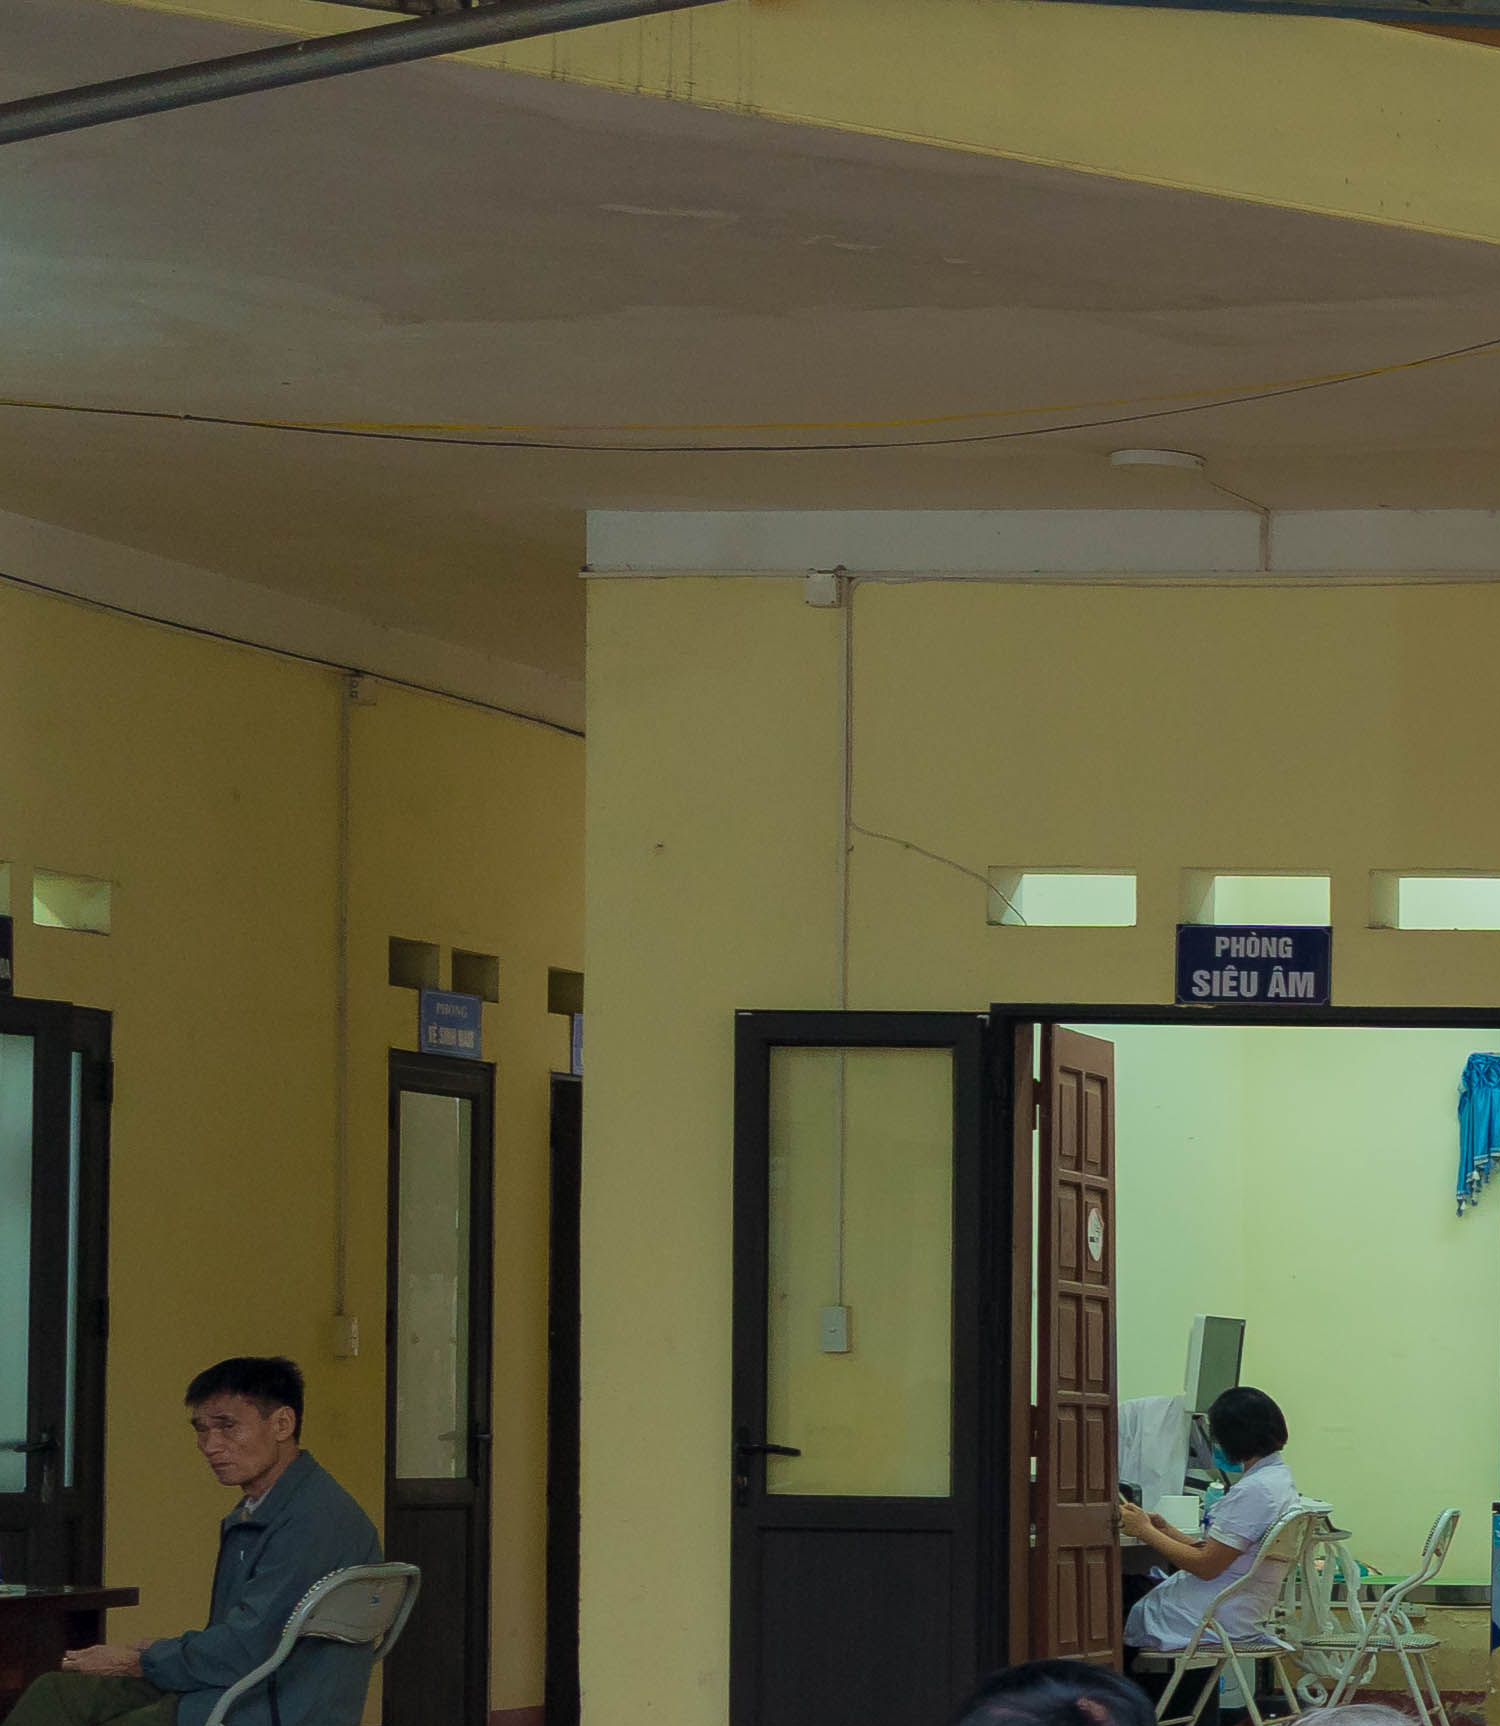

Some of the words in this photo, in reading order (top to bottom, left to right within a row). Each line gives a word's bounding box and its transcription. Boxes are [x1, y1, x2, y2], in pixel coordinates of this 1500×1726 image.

[1215, 931, 1293, 958] PHÒNG
[1192, 964, 1259, 997] SIÊU
[1267, 965, 1316, 998] ÂM
